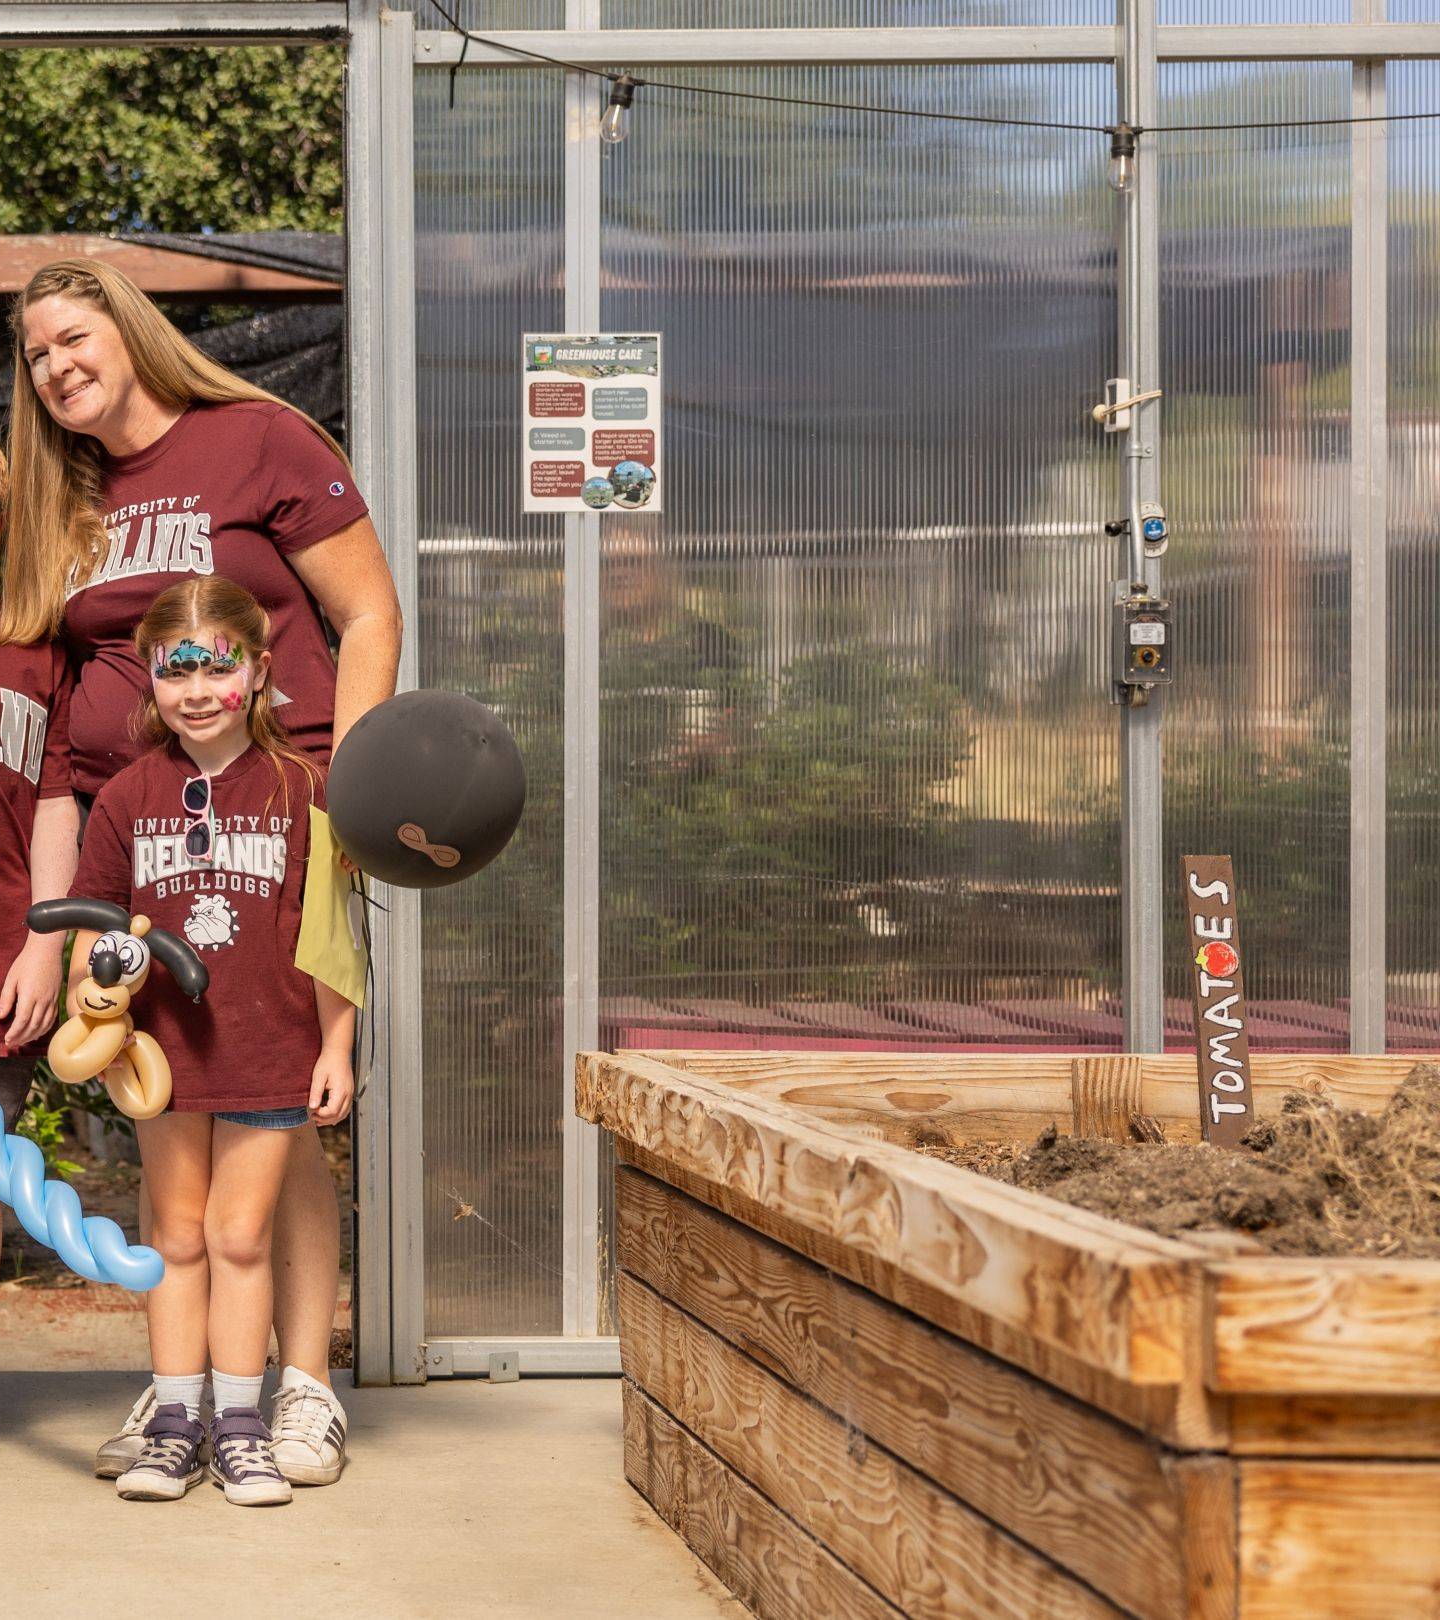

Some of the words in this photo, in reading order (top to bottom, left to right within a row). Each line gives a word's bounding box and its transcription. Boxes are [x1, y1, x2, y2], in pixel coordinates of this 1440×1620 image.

[556, 349, 616, 360] GREENHOUSE
[618, 349, 643, 360] CARE
[101, 497, 177, 527] IVERSITY
[183, 495, 200, 509] OF
[66, 511, 214, 602] DLANDS
[134, 815, 260, 835] UNIVESITY
[271, 816, 292, 833] OF
[156, 873, 270, 900] BULLDOGS
